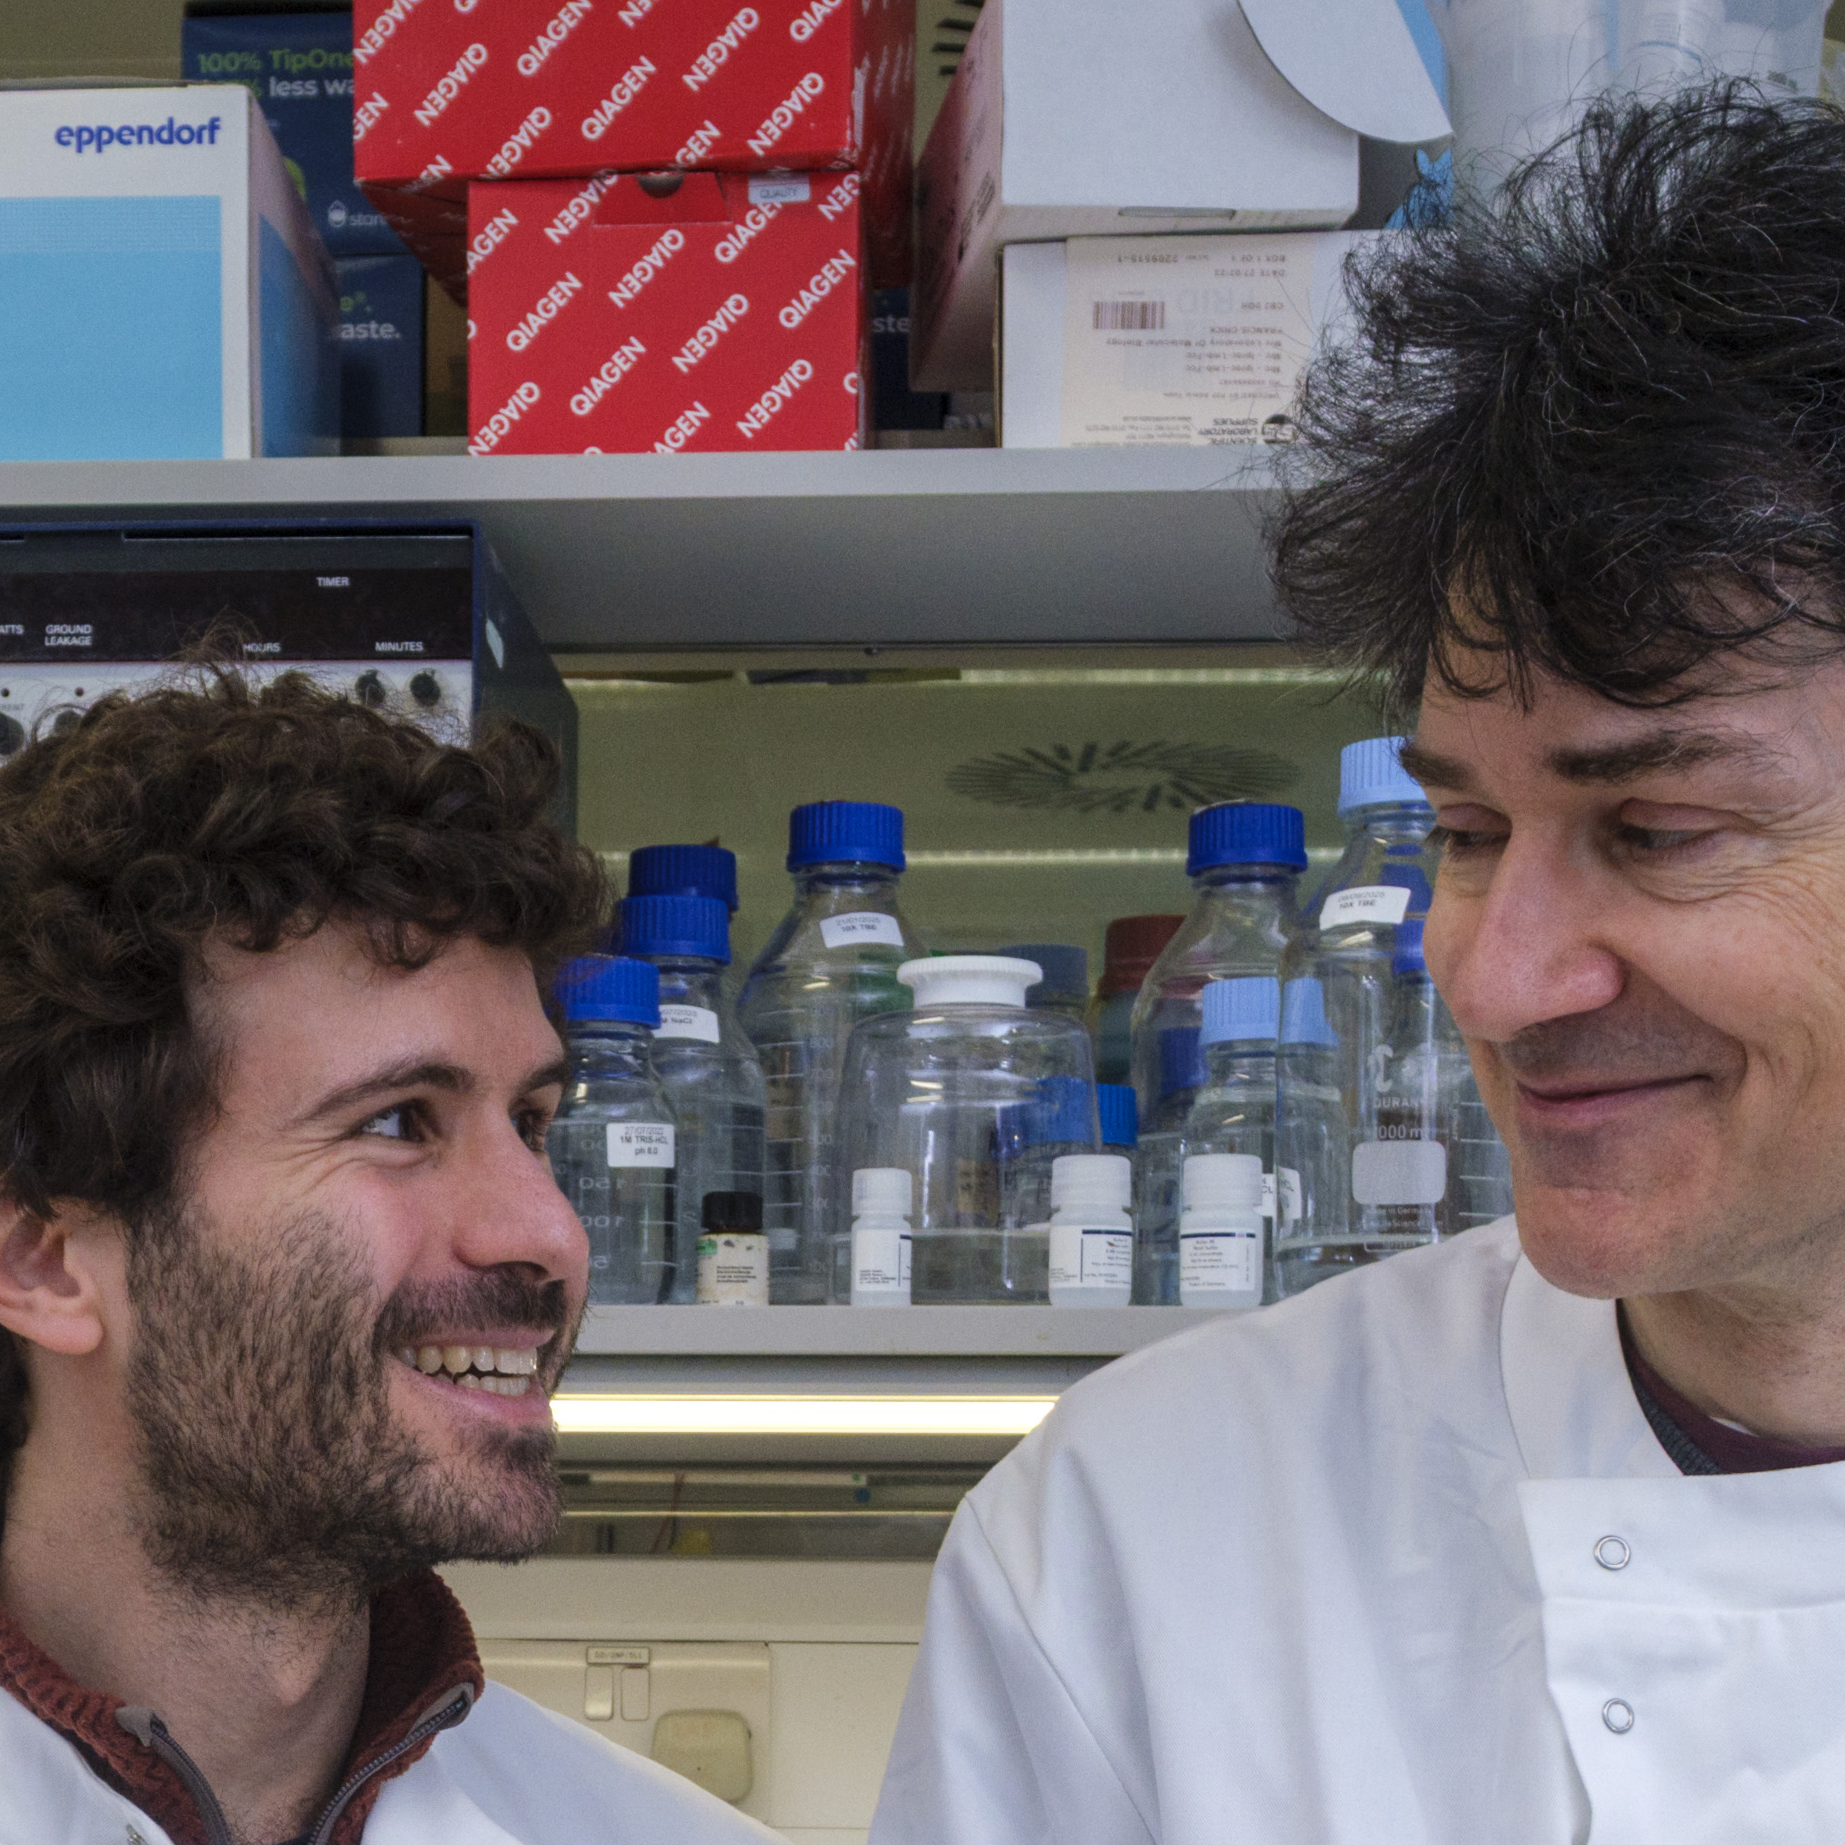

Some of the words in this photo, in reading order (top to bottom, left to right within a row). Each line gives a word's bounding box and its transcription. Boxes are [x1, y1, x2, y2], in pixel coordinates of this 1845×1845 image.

[517, 0, 592, 76] QIAGEN
[682, 7, 759, 91] QIAGEN
[270, 77, 316, 96] less
[353, 91, 389, 141] GEN
[414, 43, 488, 127] QIAGEN
[581, 56, 657, 140] QIAGEN
[747, 72, 824, 156] QIAGEN
[55, 117, 221, 153] eppendorf
[675, 120, 721, 168] GEN
[467, 208, 519, 274] AGEN
[608, 228, 685, 309] QIAGEN
[506, 271, 583, 352] QIAGEN
[778, 249, 856, 329] QIAGEN
[341, 322, 401, 339] aste.
[672, 294, 748, 373] QIAGEN
[570, 336, 646, 417] QIAGEN
[736, 359, 813, 438] QIAGEN
[1198, 427, 1258, 435] LABORATORY
[317, 577, 350, 587] TIMER
[45, 624, 93, 635] GROUND
[45, 636, 93, 646] LEAKAGE
[243, 642, 281, 653] HOURS
[375, 641, 423, 652] MINUTES
